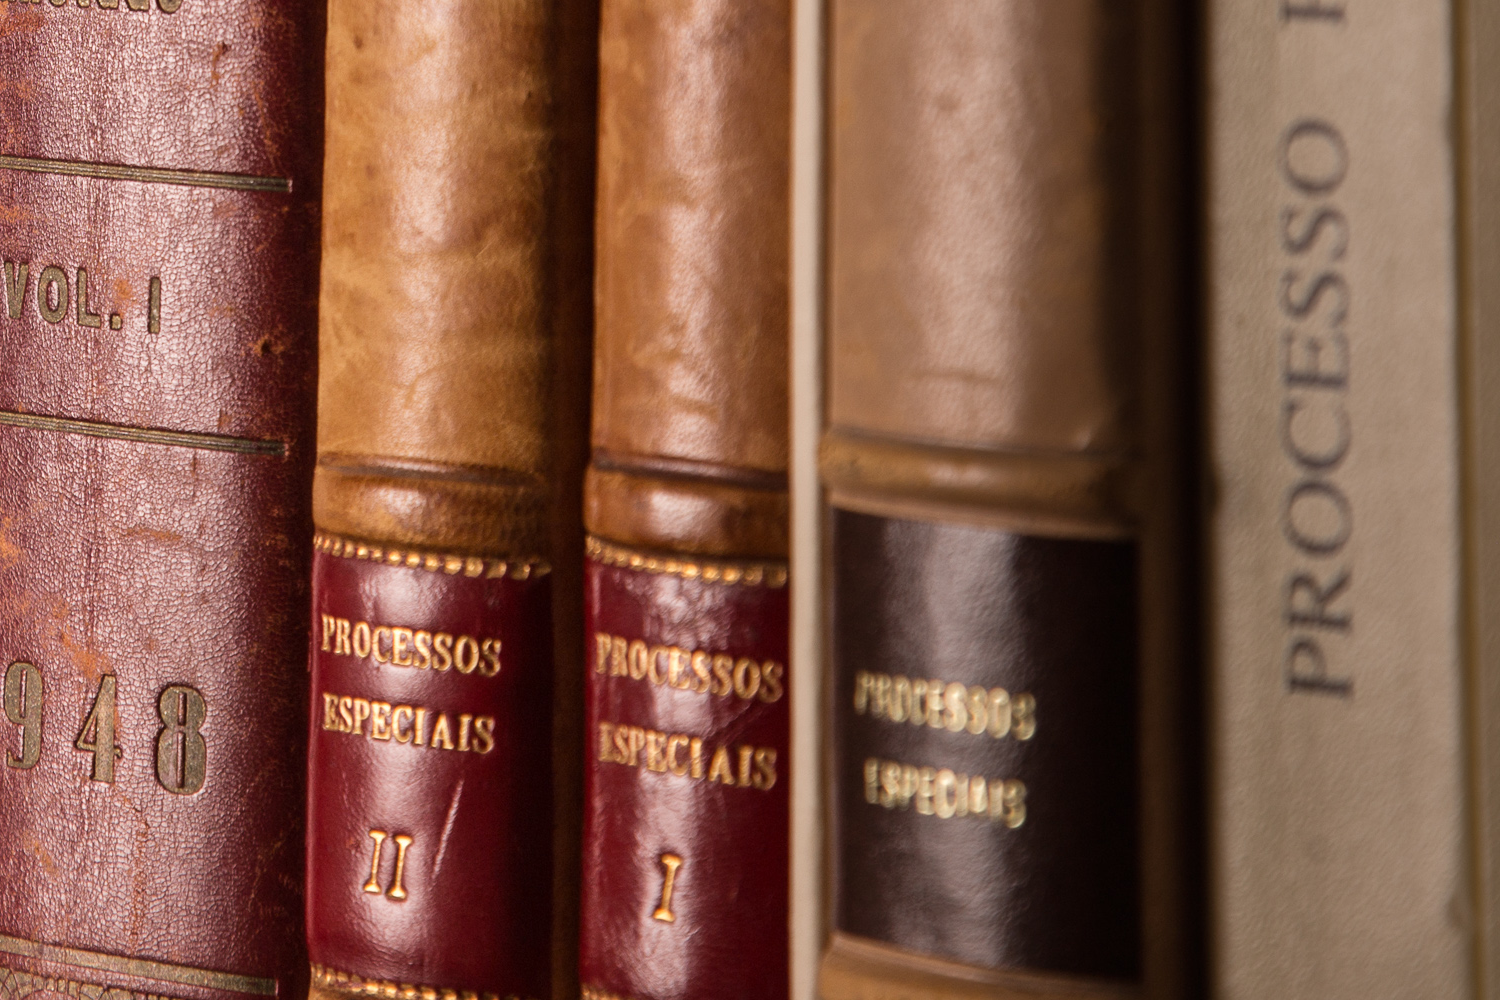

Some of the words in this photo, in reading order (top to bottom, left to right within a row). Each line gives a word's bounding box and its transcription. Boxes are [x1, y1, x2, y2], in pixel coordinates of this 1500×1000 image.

[3, 260, 123, 331] VOL.
[146, 275, 163, 335] I
[1277, 116, 1355, 701] PROCESSO
[319, 613, 502, 678] PROCESSOS
[595, 631, 784, 703] PROCESSOS
[322, 692, 496, 755] ESPECIAIS
[598, 719, 778, 792] ESPECIAIS
[362, 828, 413, 901] II
[651, 853, 684, 923] I
